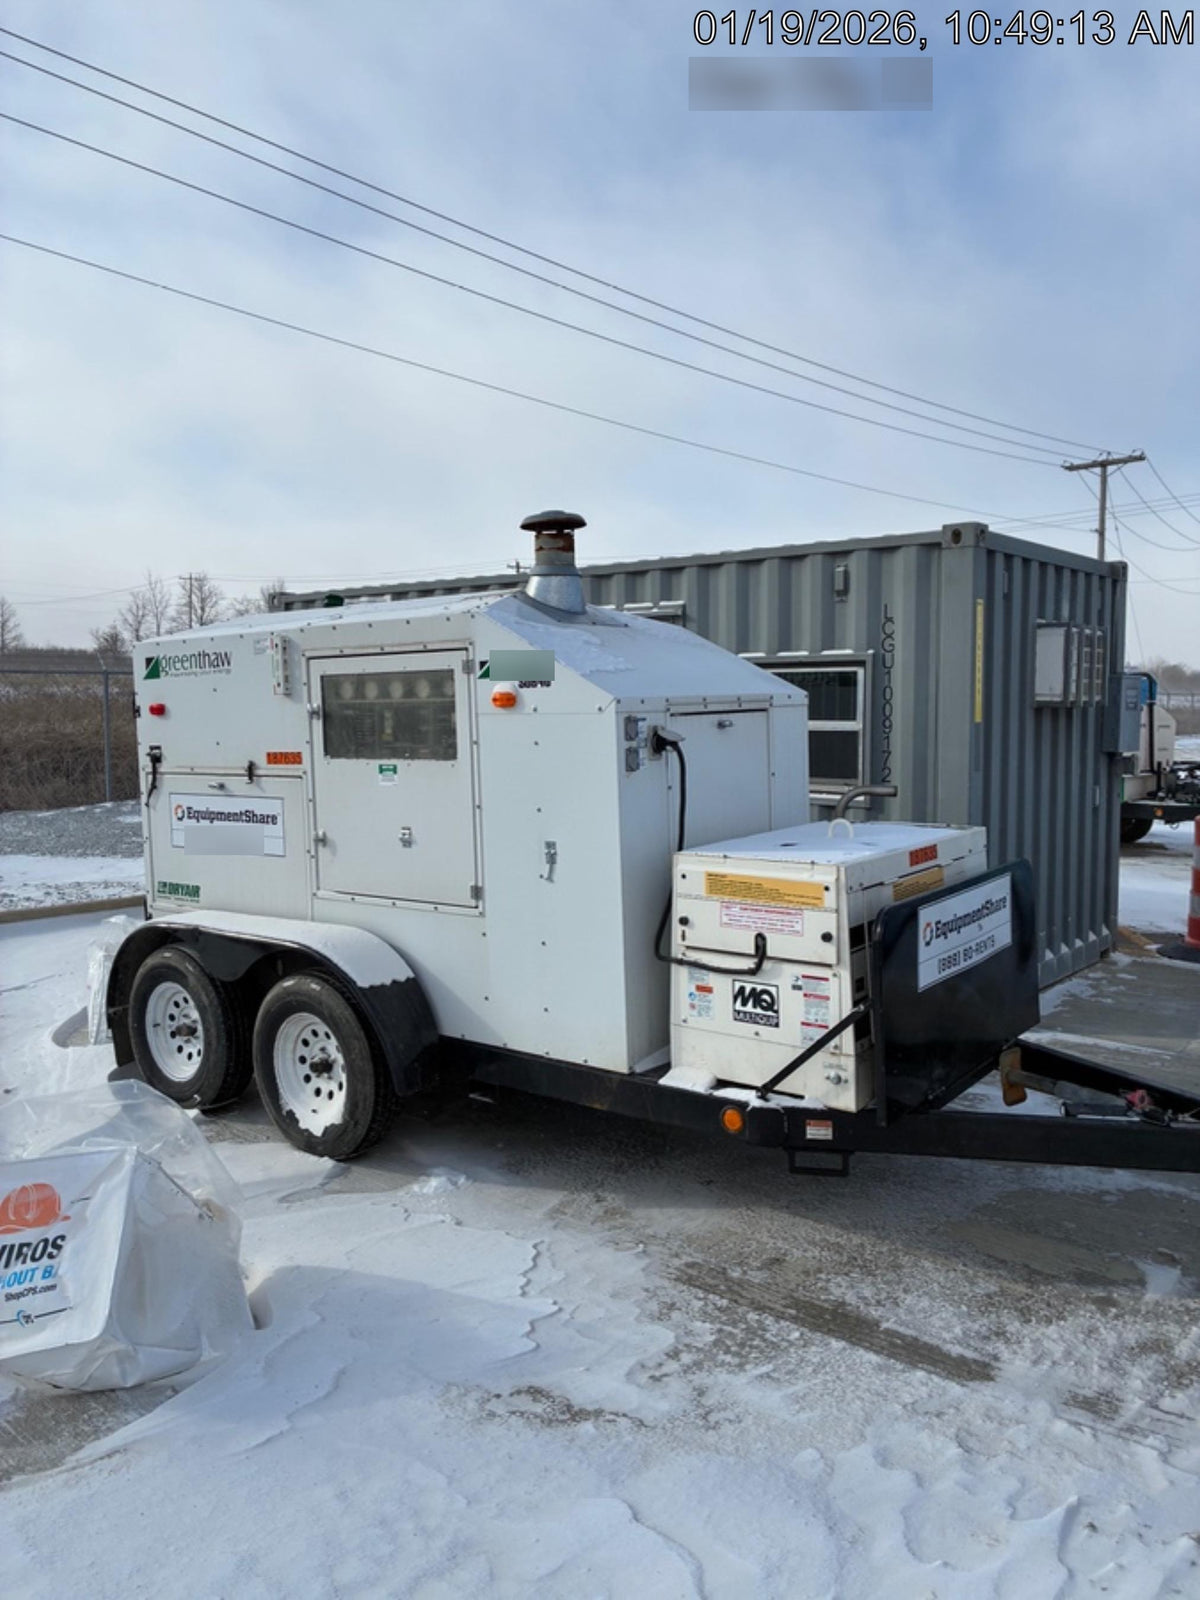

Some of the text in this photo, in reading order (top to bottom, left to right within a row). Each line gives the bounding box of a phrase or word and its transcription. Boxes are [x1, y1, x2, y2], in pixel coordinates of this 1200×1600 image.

[160, 649, 232, 677] greenthaw
[186, 807, 278, 826] EquipmentShare
[168, 882, 201, 899] DRYAIR
[934, 895, 1008, 940] EquipmentShare
[734, 985, 779, 1014] MQ
